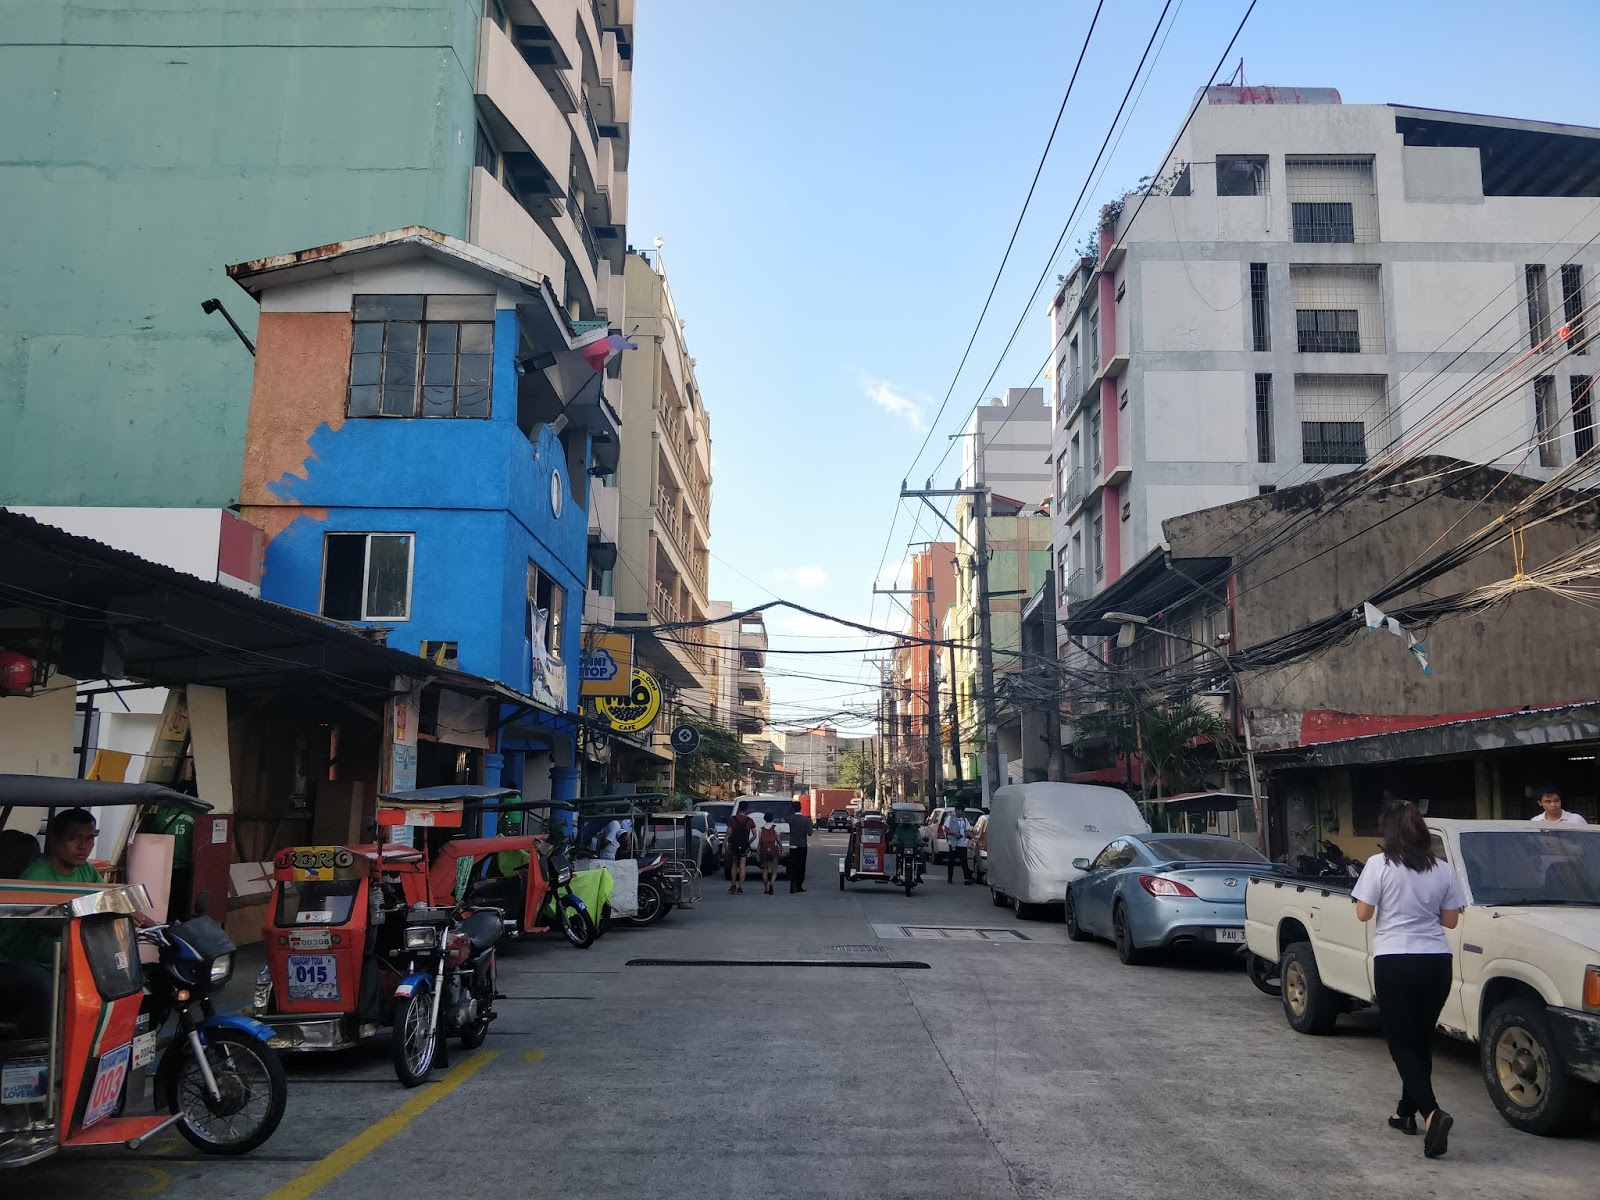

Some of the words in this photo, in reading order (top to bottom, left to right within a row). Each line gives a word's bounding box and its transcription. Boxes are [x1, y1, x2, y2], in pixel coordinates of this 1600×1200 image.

[645, 676, 657, 690] OWN
[174, 823, 186, 835] 15
[275, 850, 355, 869] JERO
[1222, 930, 1237, 939] PAU
[301, 938, 330, 946] 00308
[297, 966, 328, 982] 015
[92, 1065, 125, 1110] 003
